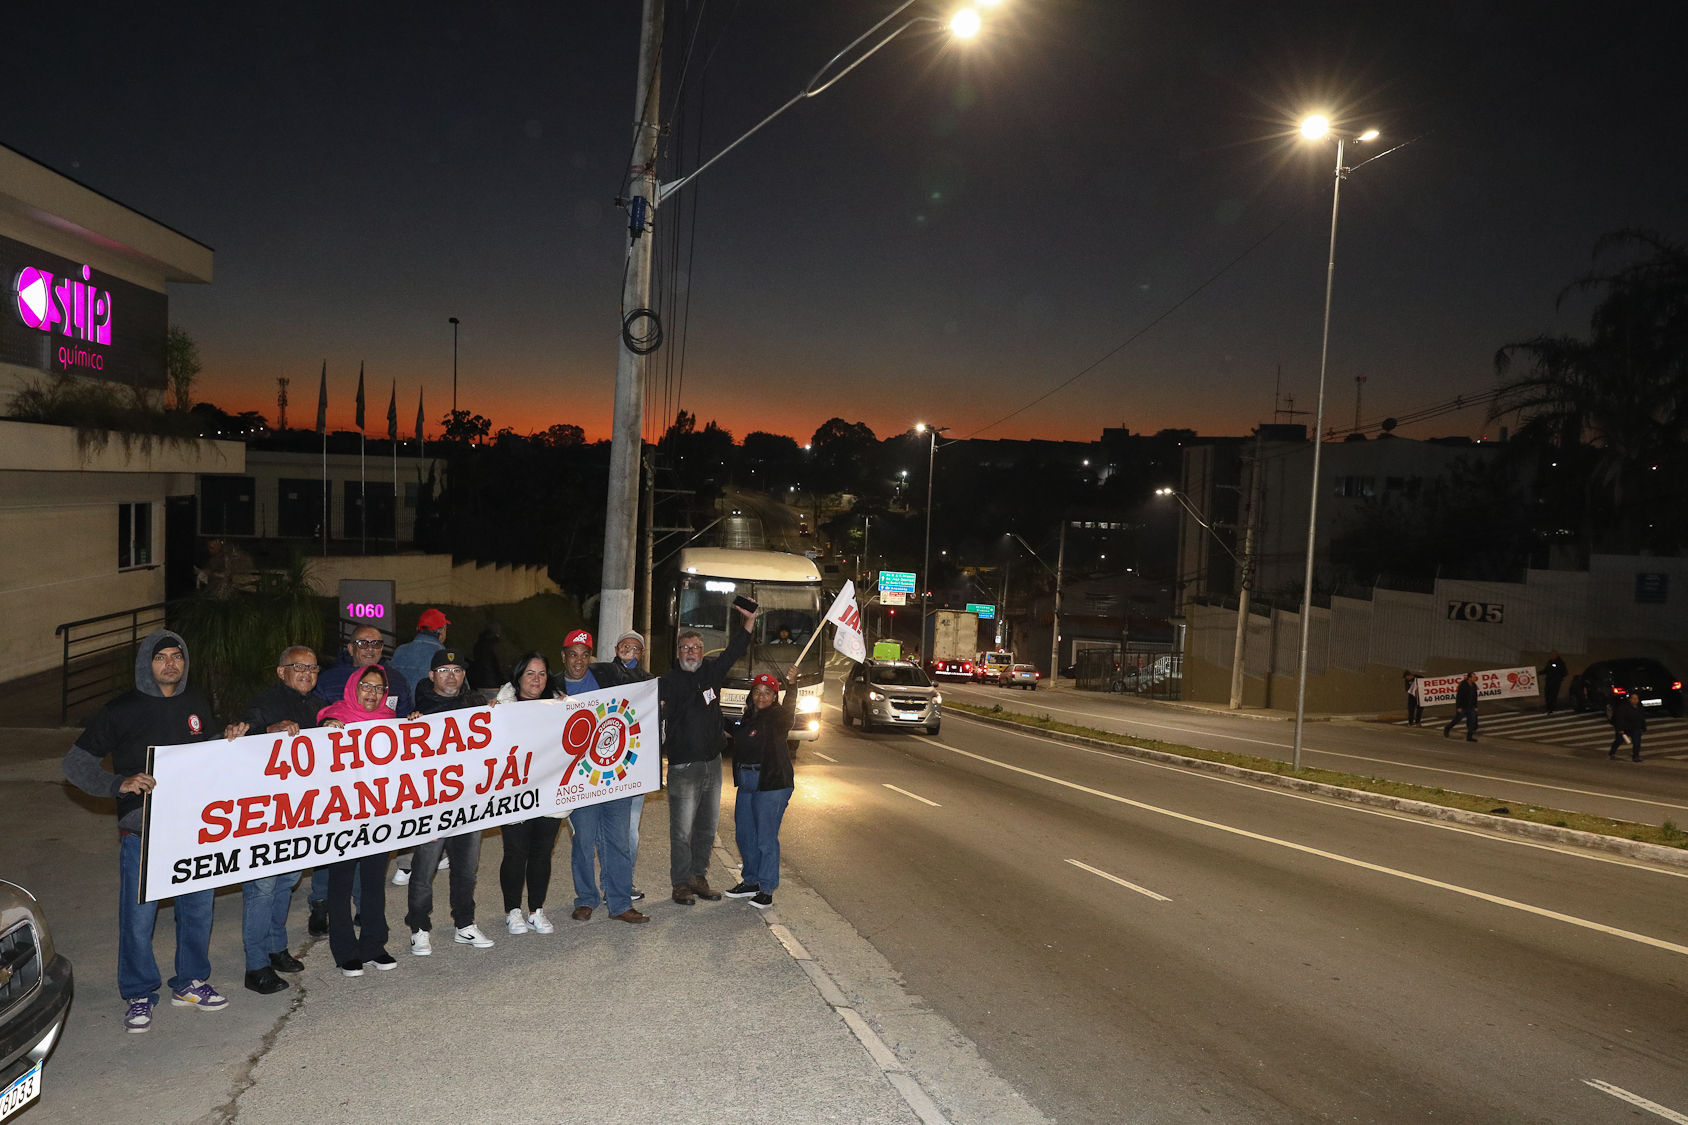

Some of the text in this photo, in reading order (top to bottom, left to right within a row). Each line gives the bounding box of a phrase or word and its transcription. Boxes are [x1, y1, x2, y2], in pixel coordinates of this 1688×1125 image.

[58, 344, 104, 370] química
[346, 603, 385, 618] 1060
[1448, 602, 1503, 623] 705
[1482, 673, 1499, 681] DA
[566, 699, 600, 711] RUMO AOS
[1434, 694, 1457, 702] HORA
[264, 710, 492, 780] 40 HORAS
[559, 709, 626, 786] 90
[198, 745, 533, 845] SEMANAIS JÁ!
[555, 789, 608, 806] CONSTRUINDO
[614, 781, 642, 793] FUTURO
[556, 783, 585, 798] ANOS
[171, 788, 541, 885] SEM REDUÇÃO DE SALÁRIO!
[0, 1076, 34, 1116] 8D33
